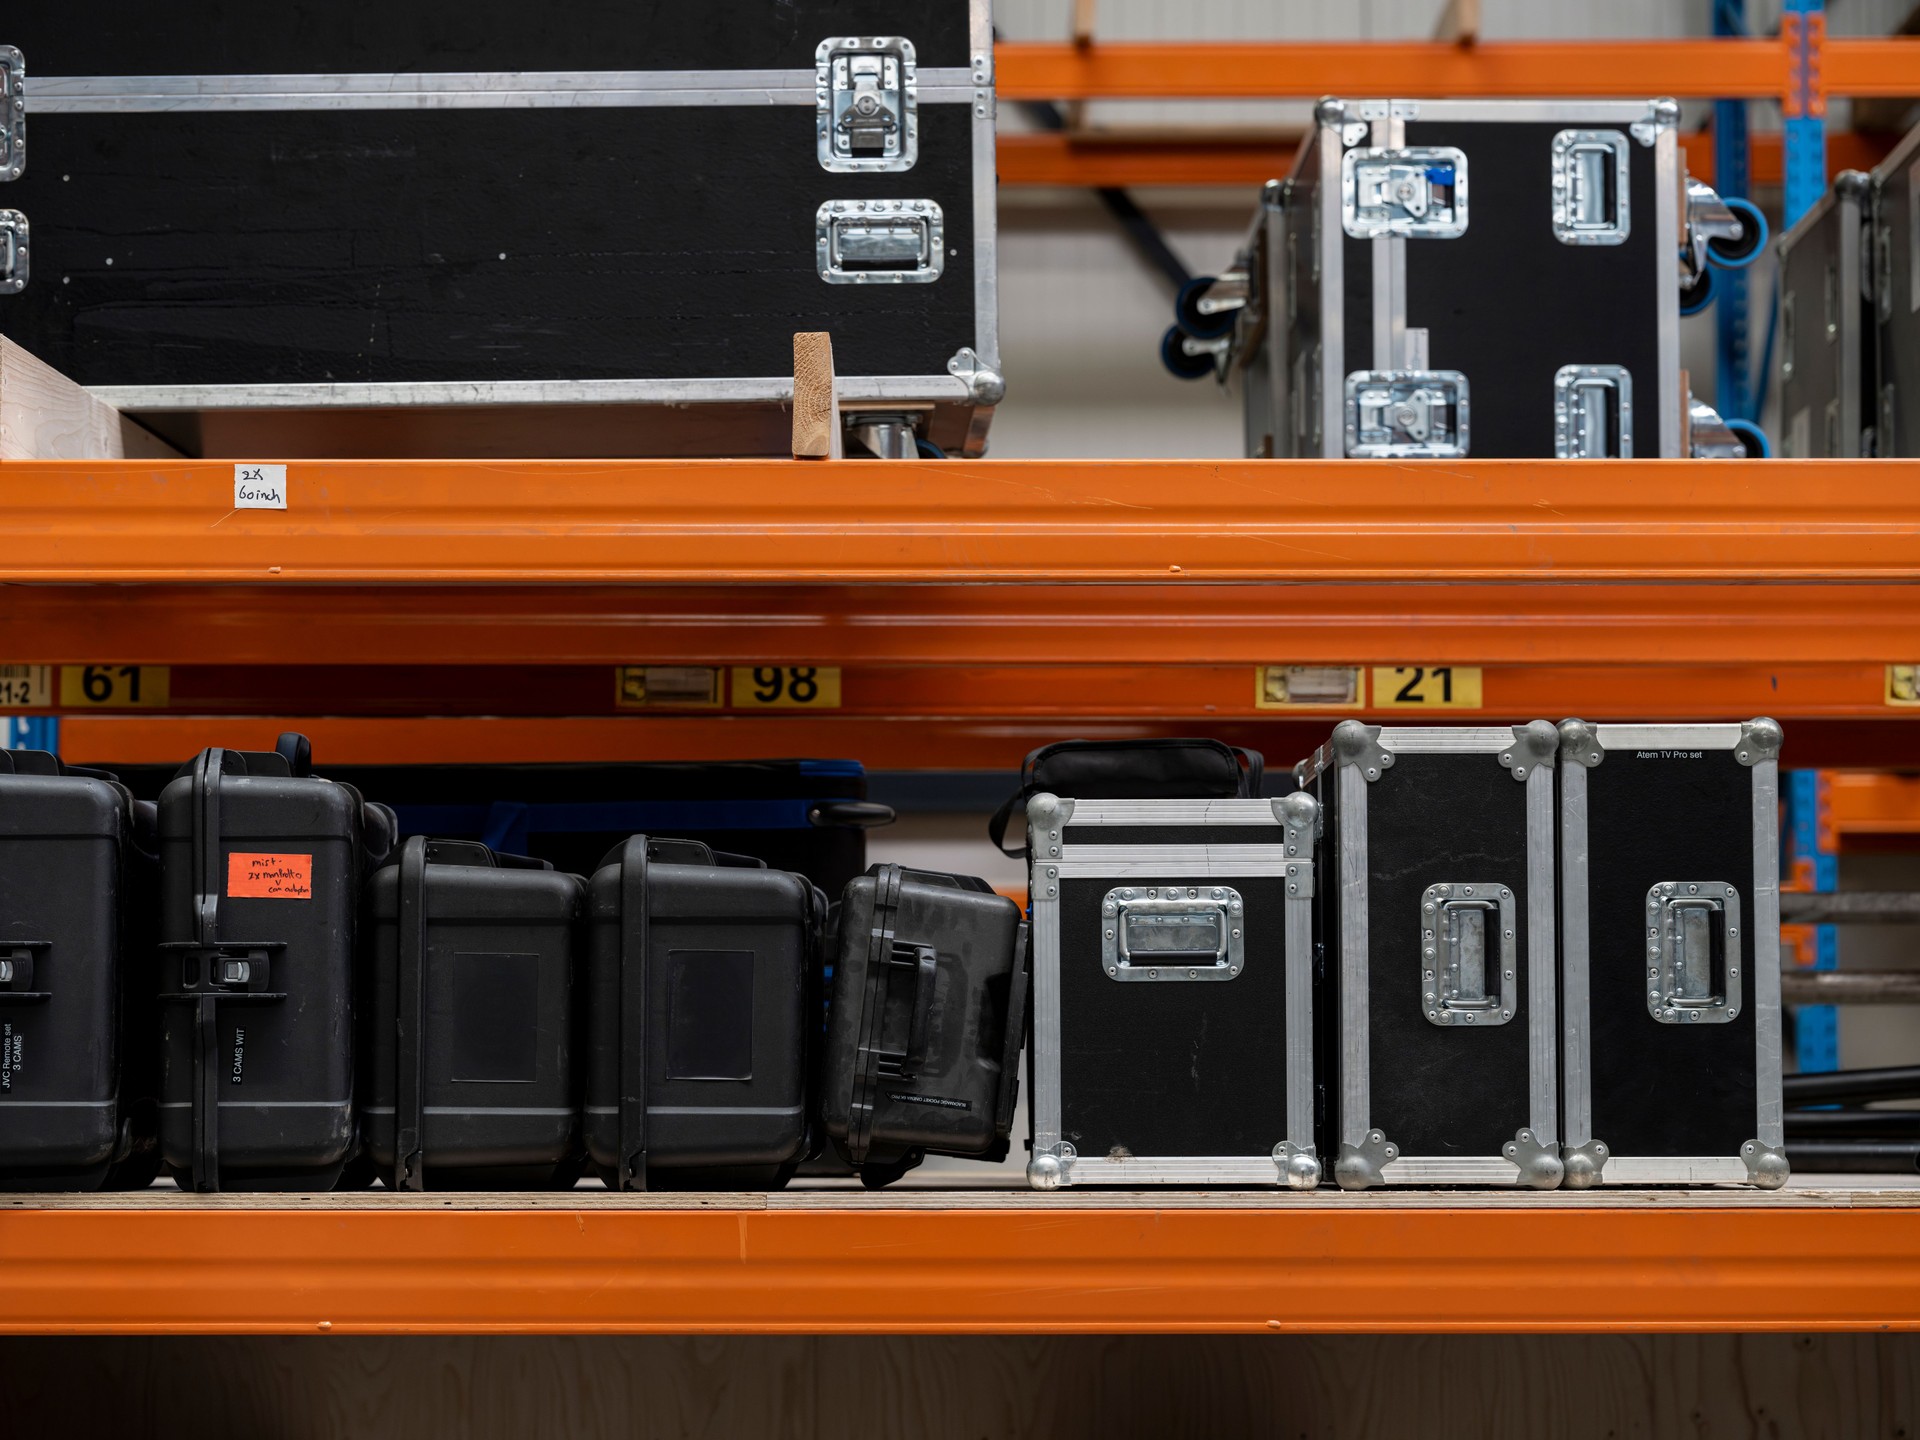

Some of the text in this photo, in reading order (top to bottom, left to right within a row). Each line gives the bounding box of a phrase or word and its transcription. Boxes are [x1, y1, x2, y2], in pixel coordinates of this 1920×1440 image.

[82, 666, 142, 703] 61
[753, 667, 818, 703] 98
[1394, 667, 1453, 703] 21
[1636, 751, 1703, 759] Atem TV Pro set
[12, 1035, 22, 1063] CAMS
[235, 1027, 245, 1046] WIT
[2, 1023, 12, 1089] JVC Remote set
[233, 1047, 244, 1075] CAMS
